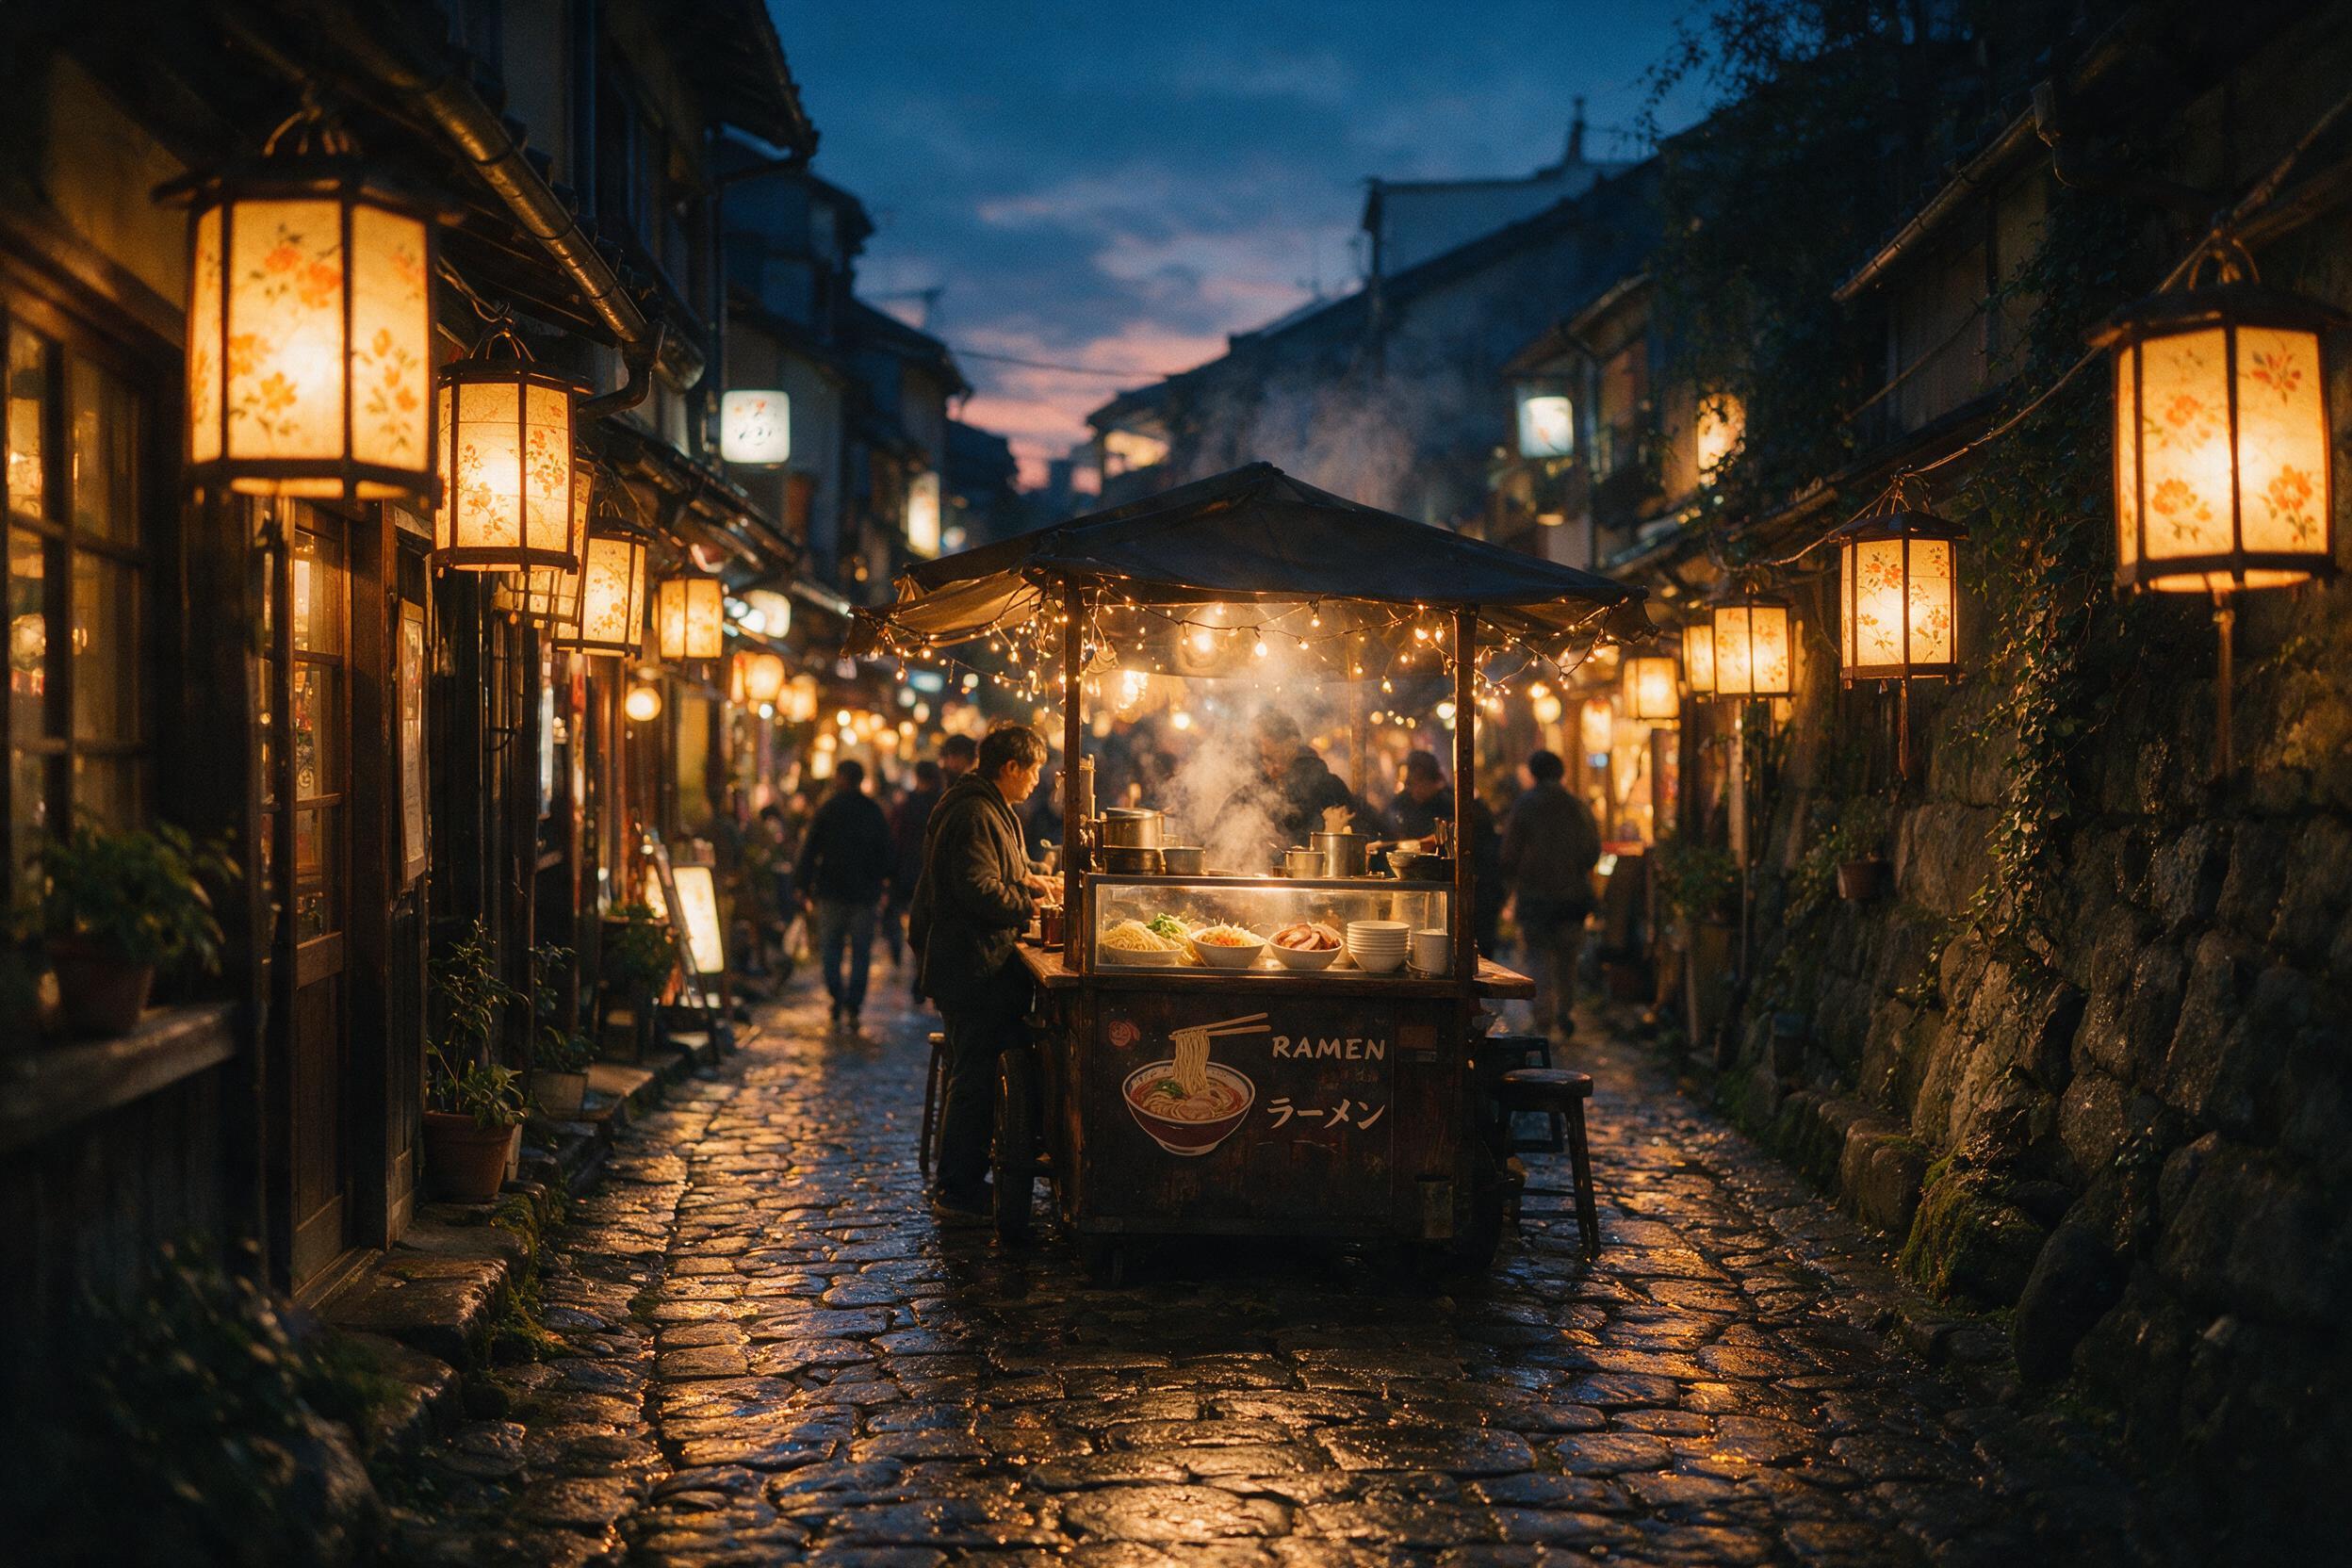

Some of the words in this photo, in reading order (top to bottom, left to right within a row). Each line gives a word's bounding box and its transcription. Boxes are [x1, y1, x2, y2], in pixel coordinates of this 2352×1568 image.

[1272, 1035, 1385, 1061] RAMEN
[1267, 1097, 1386, 1130] ラーメン
